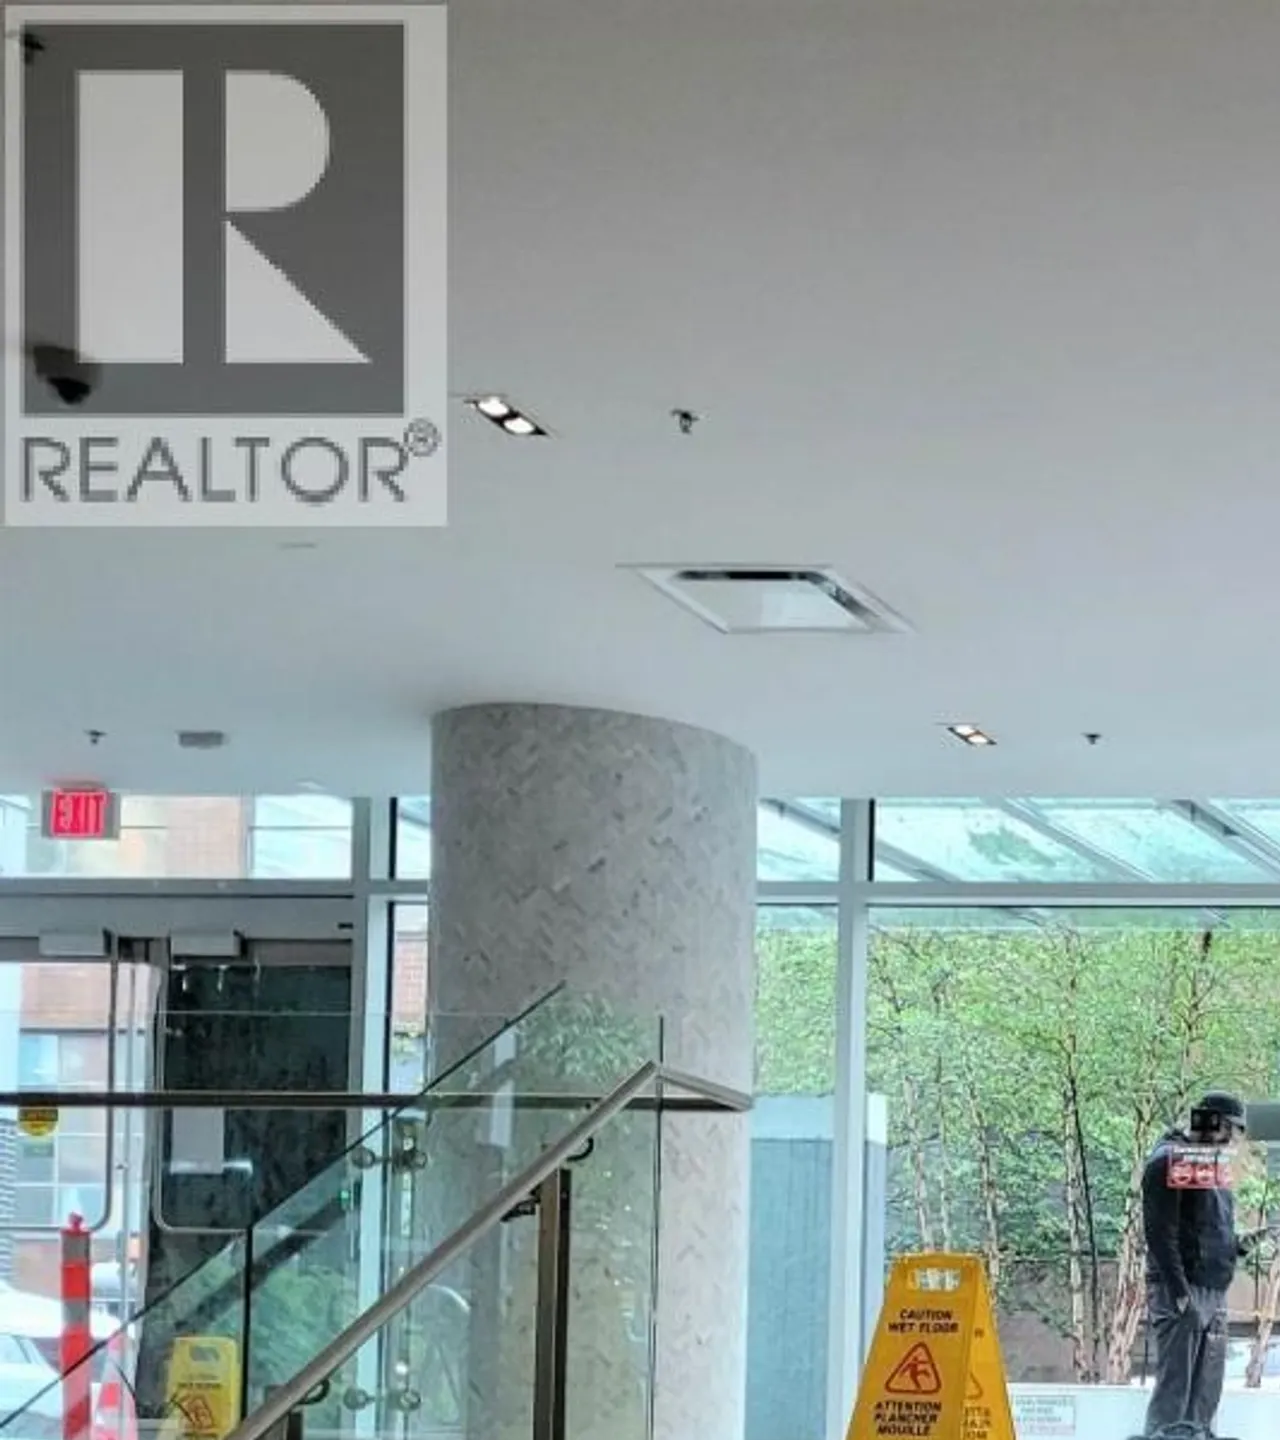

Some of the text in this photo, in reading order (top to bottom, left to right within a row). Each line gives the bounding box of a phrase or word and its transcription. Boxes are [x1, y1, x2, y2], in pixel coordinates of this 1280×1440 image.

[54, 794, 105, 834] EXIT
[900, 1309, 953, 1321] CAUTION
[887, 1322, 959, 1334] WET FLOOR
[874, 1401, 942, 1412] ATTENTION
[874, 1412, 938, 1424] PLANCHER
